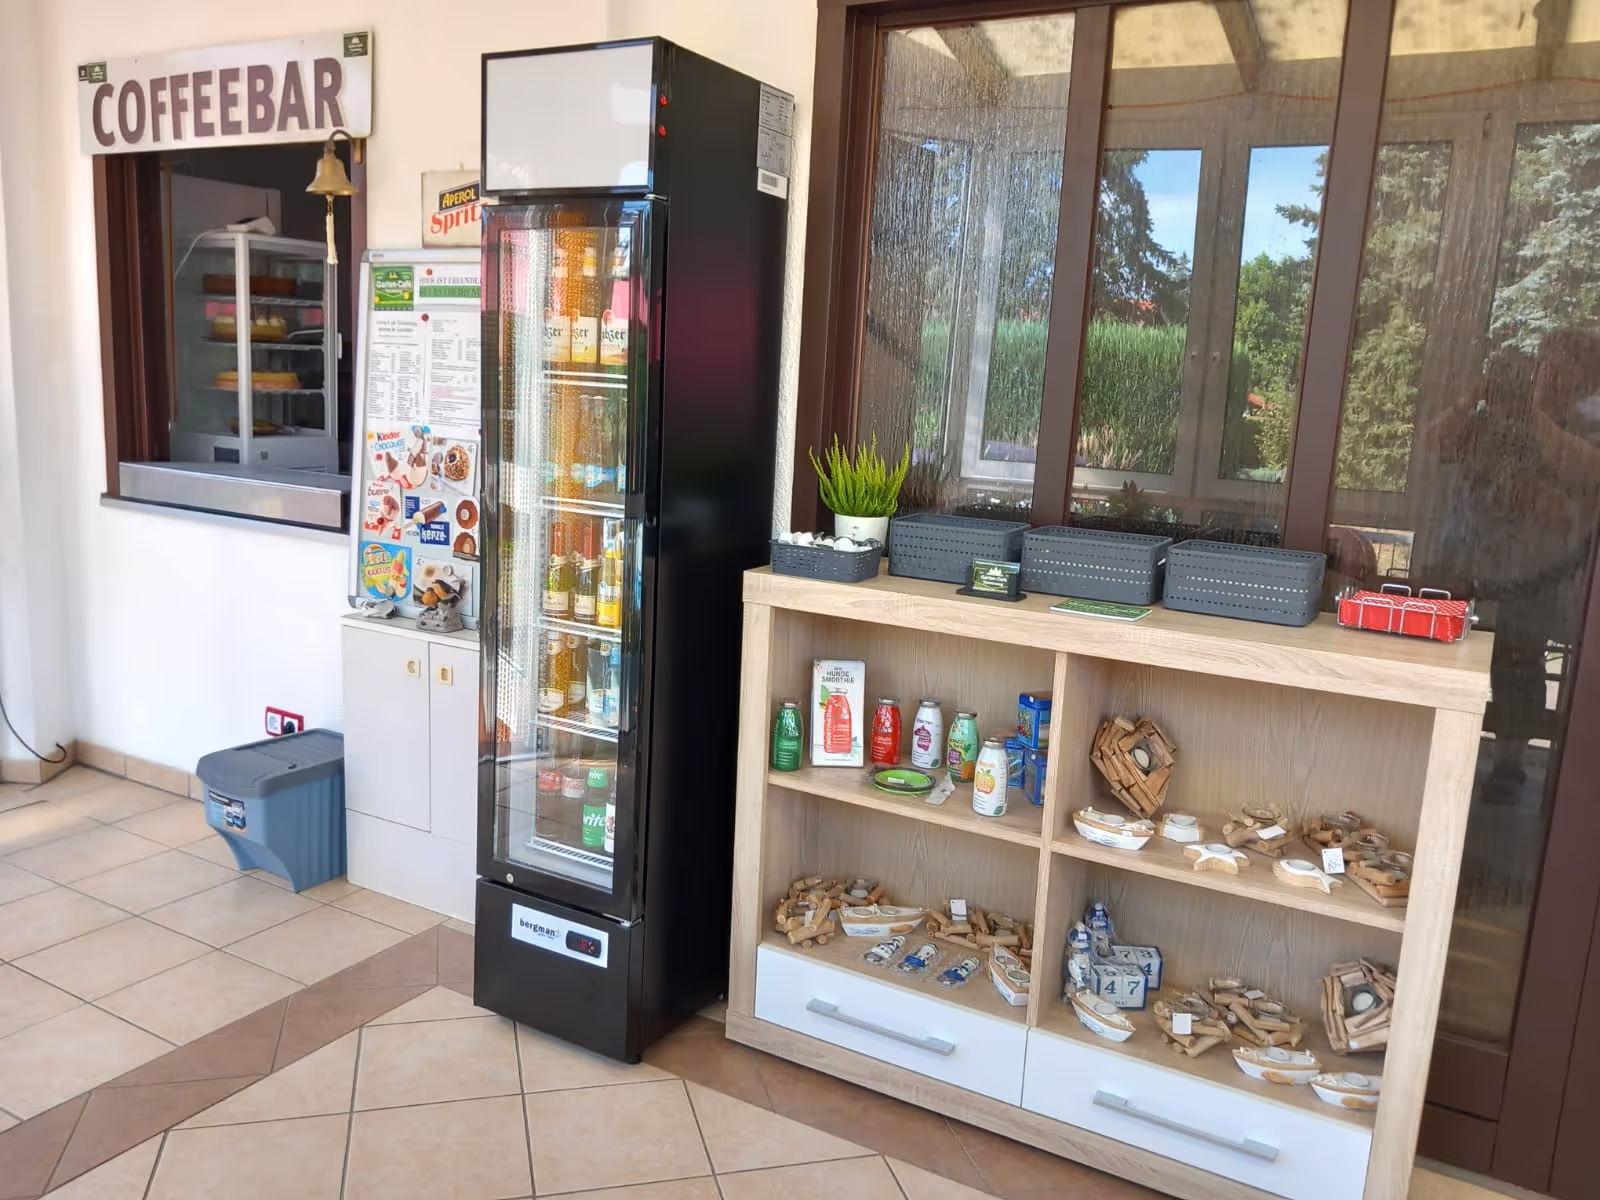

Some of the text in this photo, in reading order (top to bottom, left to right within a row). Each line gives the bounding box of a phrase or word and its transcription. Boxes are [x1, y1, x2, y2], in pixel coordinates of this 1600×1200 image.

[92, 56, 345, 148] COFFEEBAR
[442, 187, 477, 209] APEROL
[375, 439, 405, 451] CHOCOLATE
[821, 676, 855, 684] SMOOTHIE
[826, 670, 850, 678] HUNDE
[1104, 980, 1140, 995] 4 7
